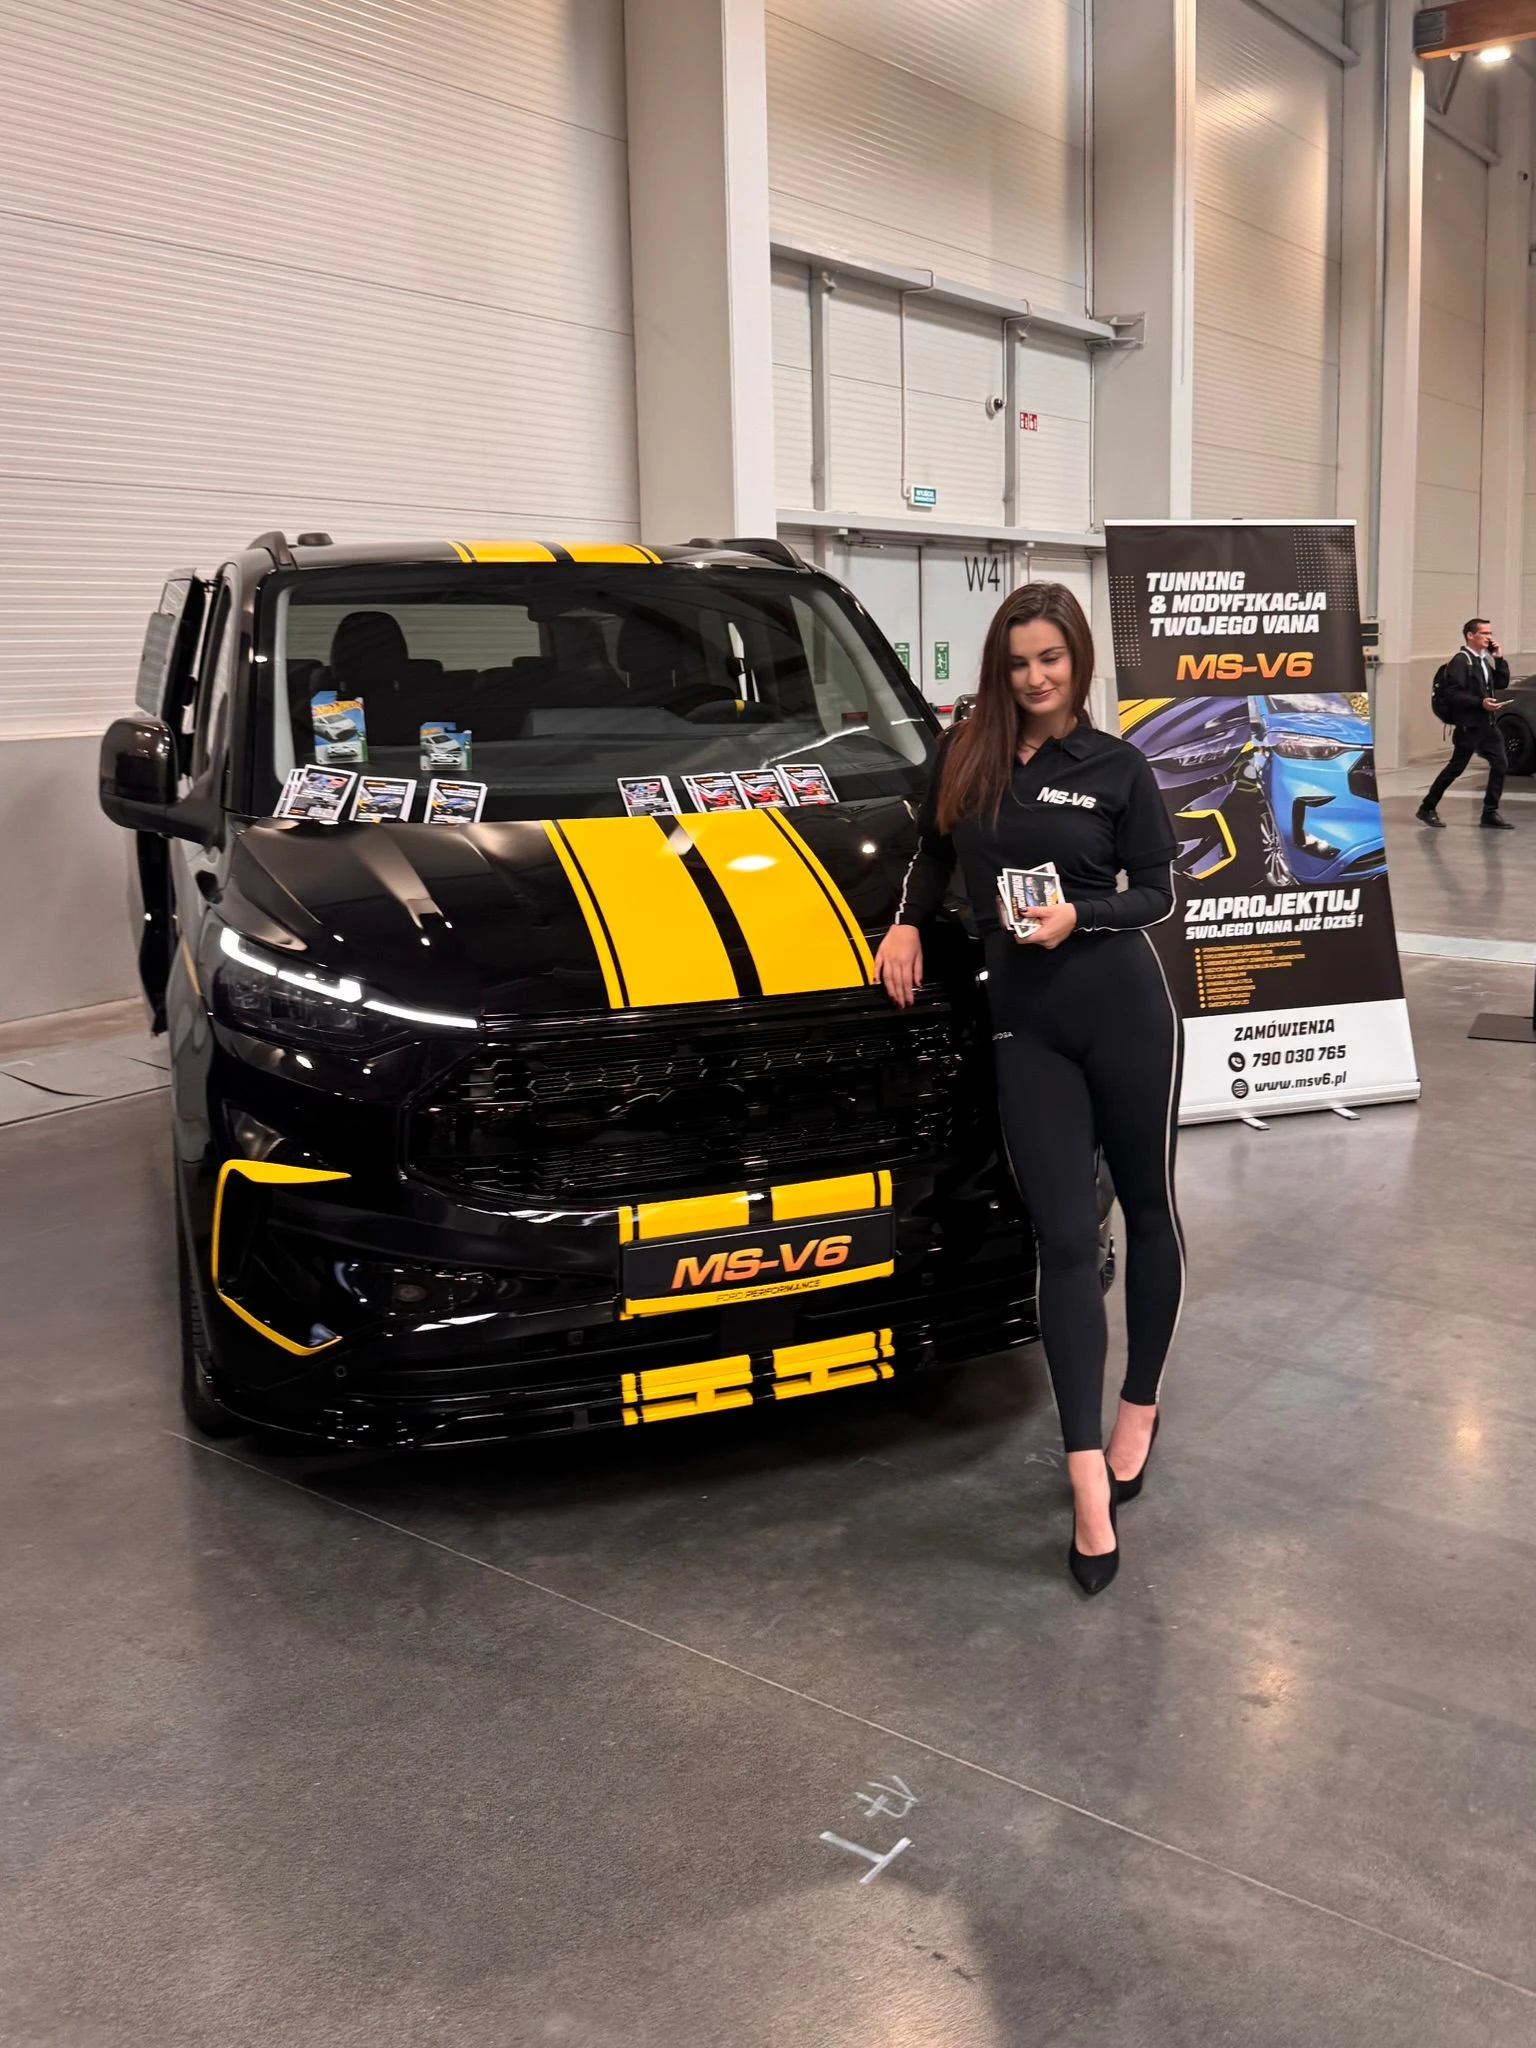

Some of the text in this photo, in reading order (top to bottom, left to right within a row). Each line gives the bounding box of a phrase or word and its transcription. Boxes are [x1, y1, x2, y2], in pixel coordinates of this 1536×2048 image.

[964, 556, 1000, 592] W4
[1146, 571, 1245, 592] TUNNING
[1149, 592, 1327, 614] & MODYFIKACJA
[1150, 614, 1320, 637] TWOJEGO VANA
[1176, 652, 1313, 680] MS-V6
[1036, 786, 1097, 809] MS-V6
[1184, 888, 1361, 923] ZAPROJEKTUJ
[1185, 922, 1254, 940] SWOJEGO
[1255, 919, 1293, 935] VANA
[1294, 914, 1322, 931] JUŻ
[1233, 1018, 1335, 1042] ZAMÓWIENIA
[1251, 1045, 1346, 1068] 790 030 765
[1254, 1071, 1347, 1093] www.msv6.pl
[671, 1235, 852, 1290] MS-V6
[744, 1279, 821, 1299] PERFORMANCE
